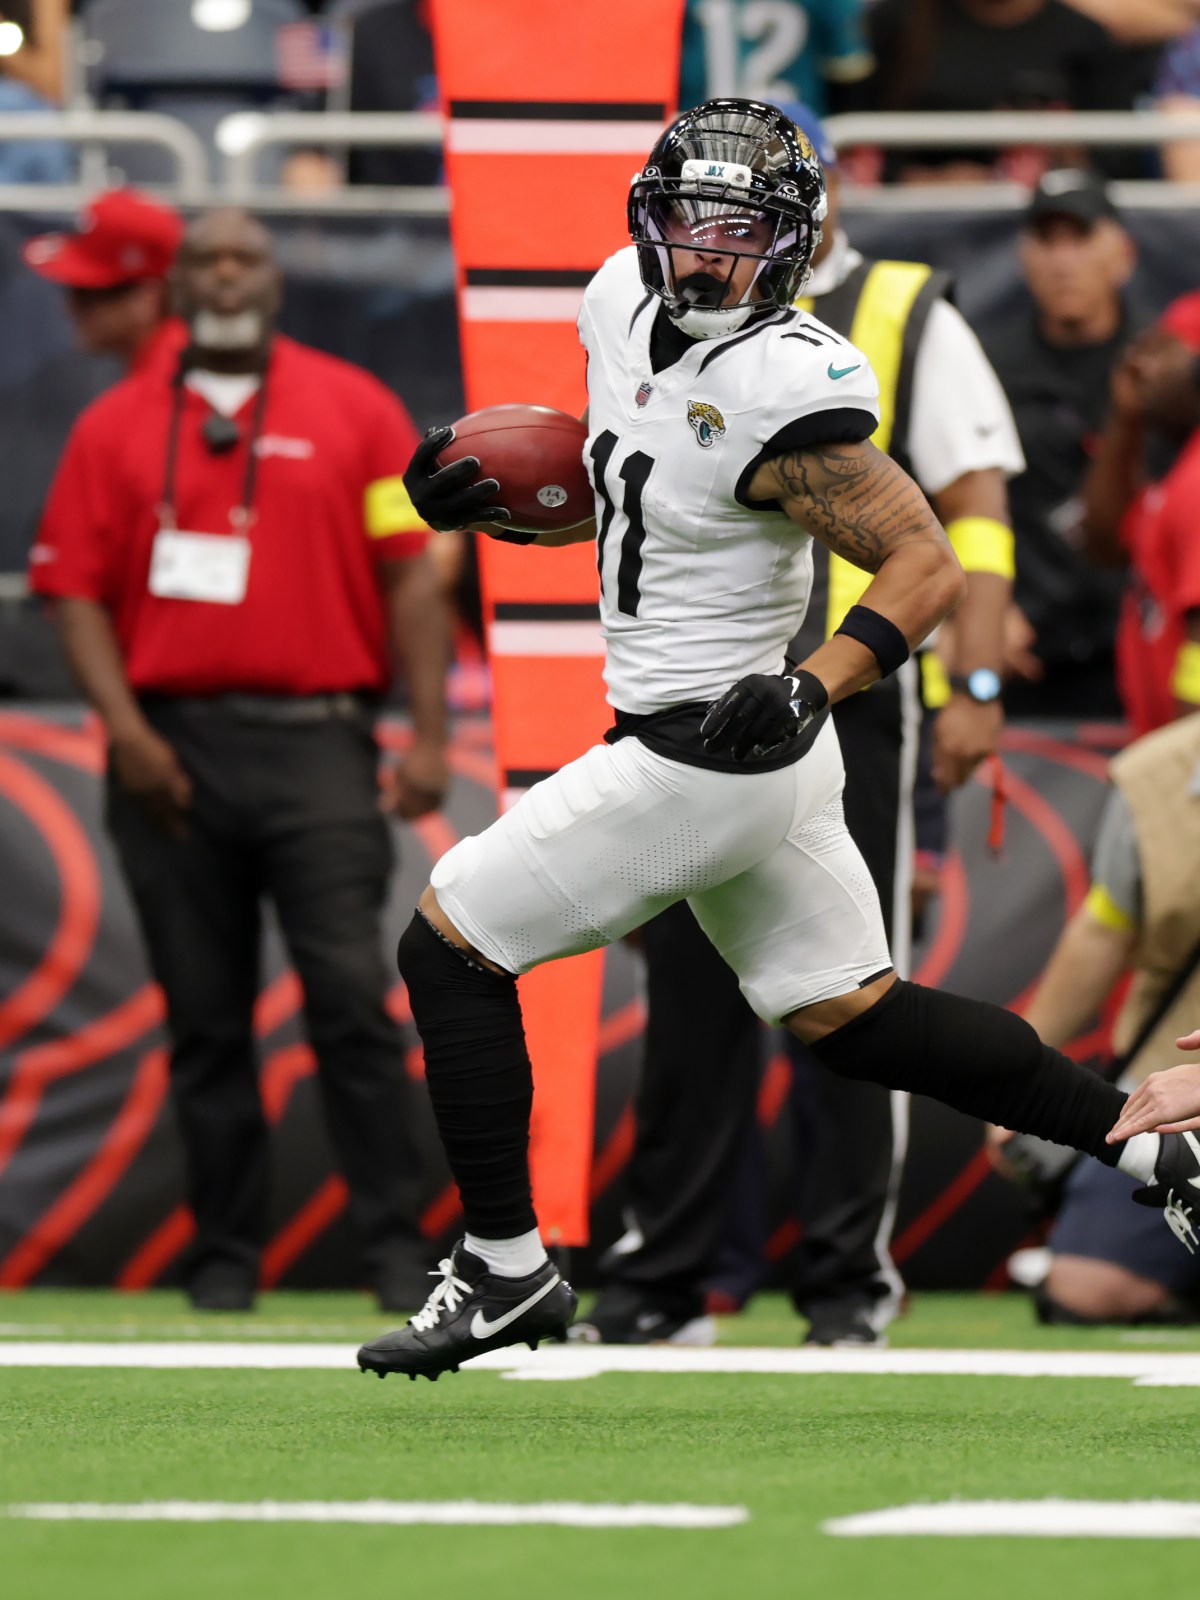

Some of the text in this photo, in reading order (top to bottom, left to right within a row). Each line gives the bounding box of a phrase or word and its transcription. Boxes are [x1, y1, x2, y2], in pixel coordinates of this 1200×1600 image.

[698, 1, 808, 102] 12
[704, 165, 725, 178] JAX
[780, 323, 842, 347] 11
[589, 428, 656, 618] 11
